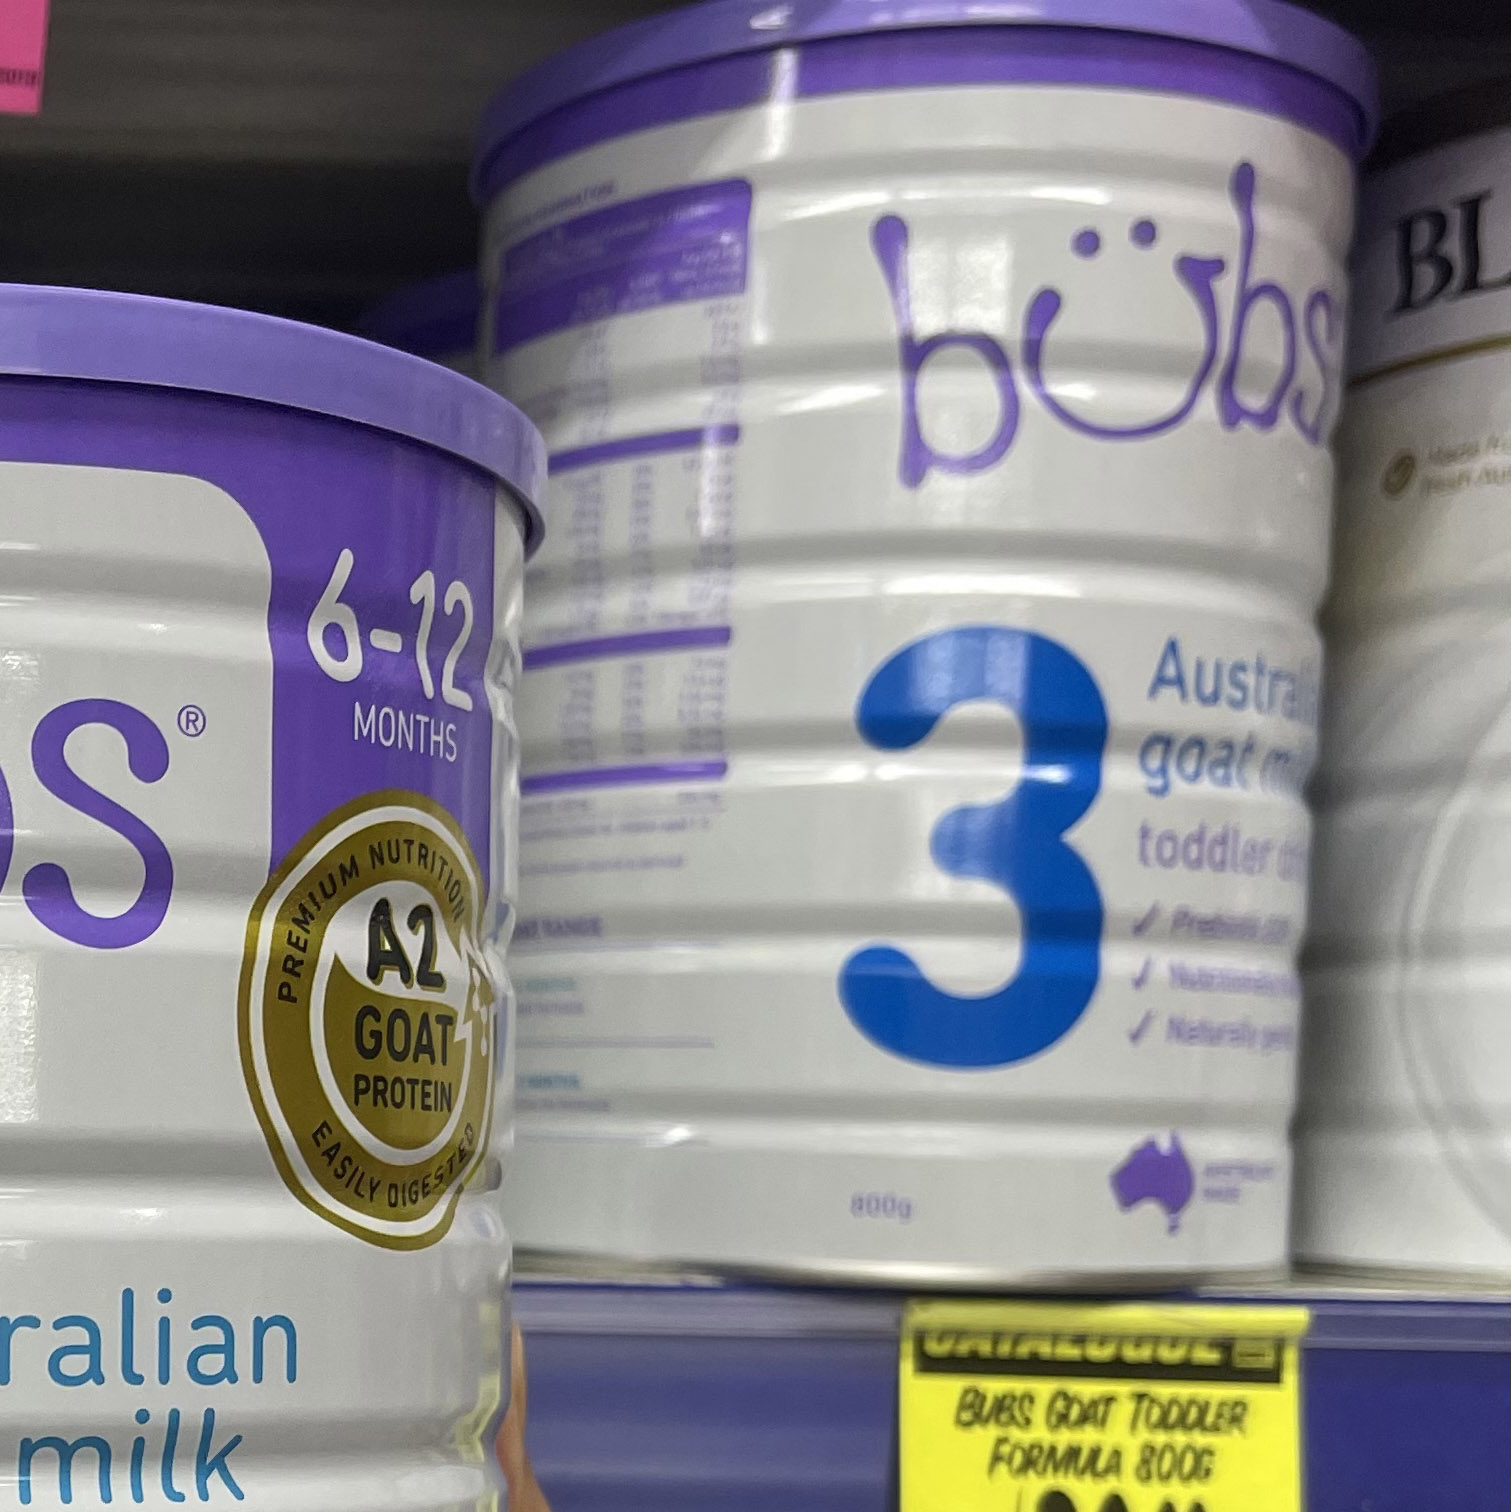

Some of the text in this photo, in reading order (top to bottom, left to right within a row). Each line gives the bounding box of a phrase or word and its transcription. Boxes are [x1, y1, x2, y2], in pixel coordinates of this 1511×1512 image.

[306, 548, 475, 713] 6-12
[352, 701, 458, 762] MONTHS
[1138, 727, 1257, 799] goat
[837, 625, 1109, 1072] 3
[1137, 821, 1273, 876] toddler
[277, 838, 464, 1003] PREMIUM NUTRITION
[366, 896, 446, 993] A2
[353, 1005, 454, 1067] GOAT
[353, 1073, 453, 1114] PROTEIN
[311, 1119, 475, 1208] EASILY DIGESTED
[850, 1191, 913, 1223] 800g
[955, 1385, 1249, 1436] BUBS GOAT TODDLER
[18, 1407, 248, 1508] milk
[988, 1436, 1216, 1484] FORMULA 800G
